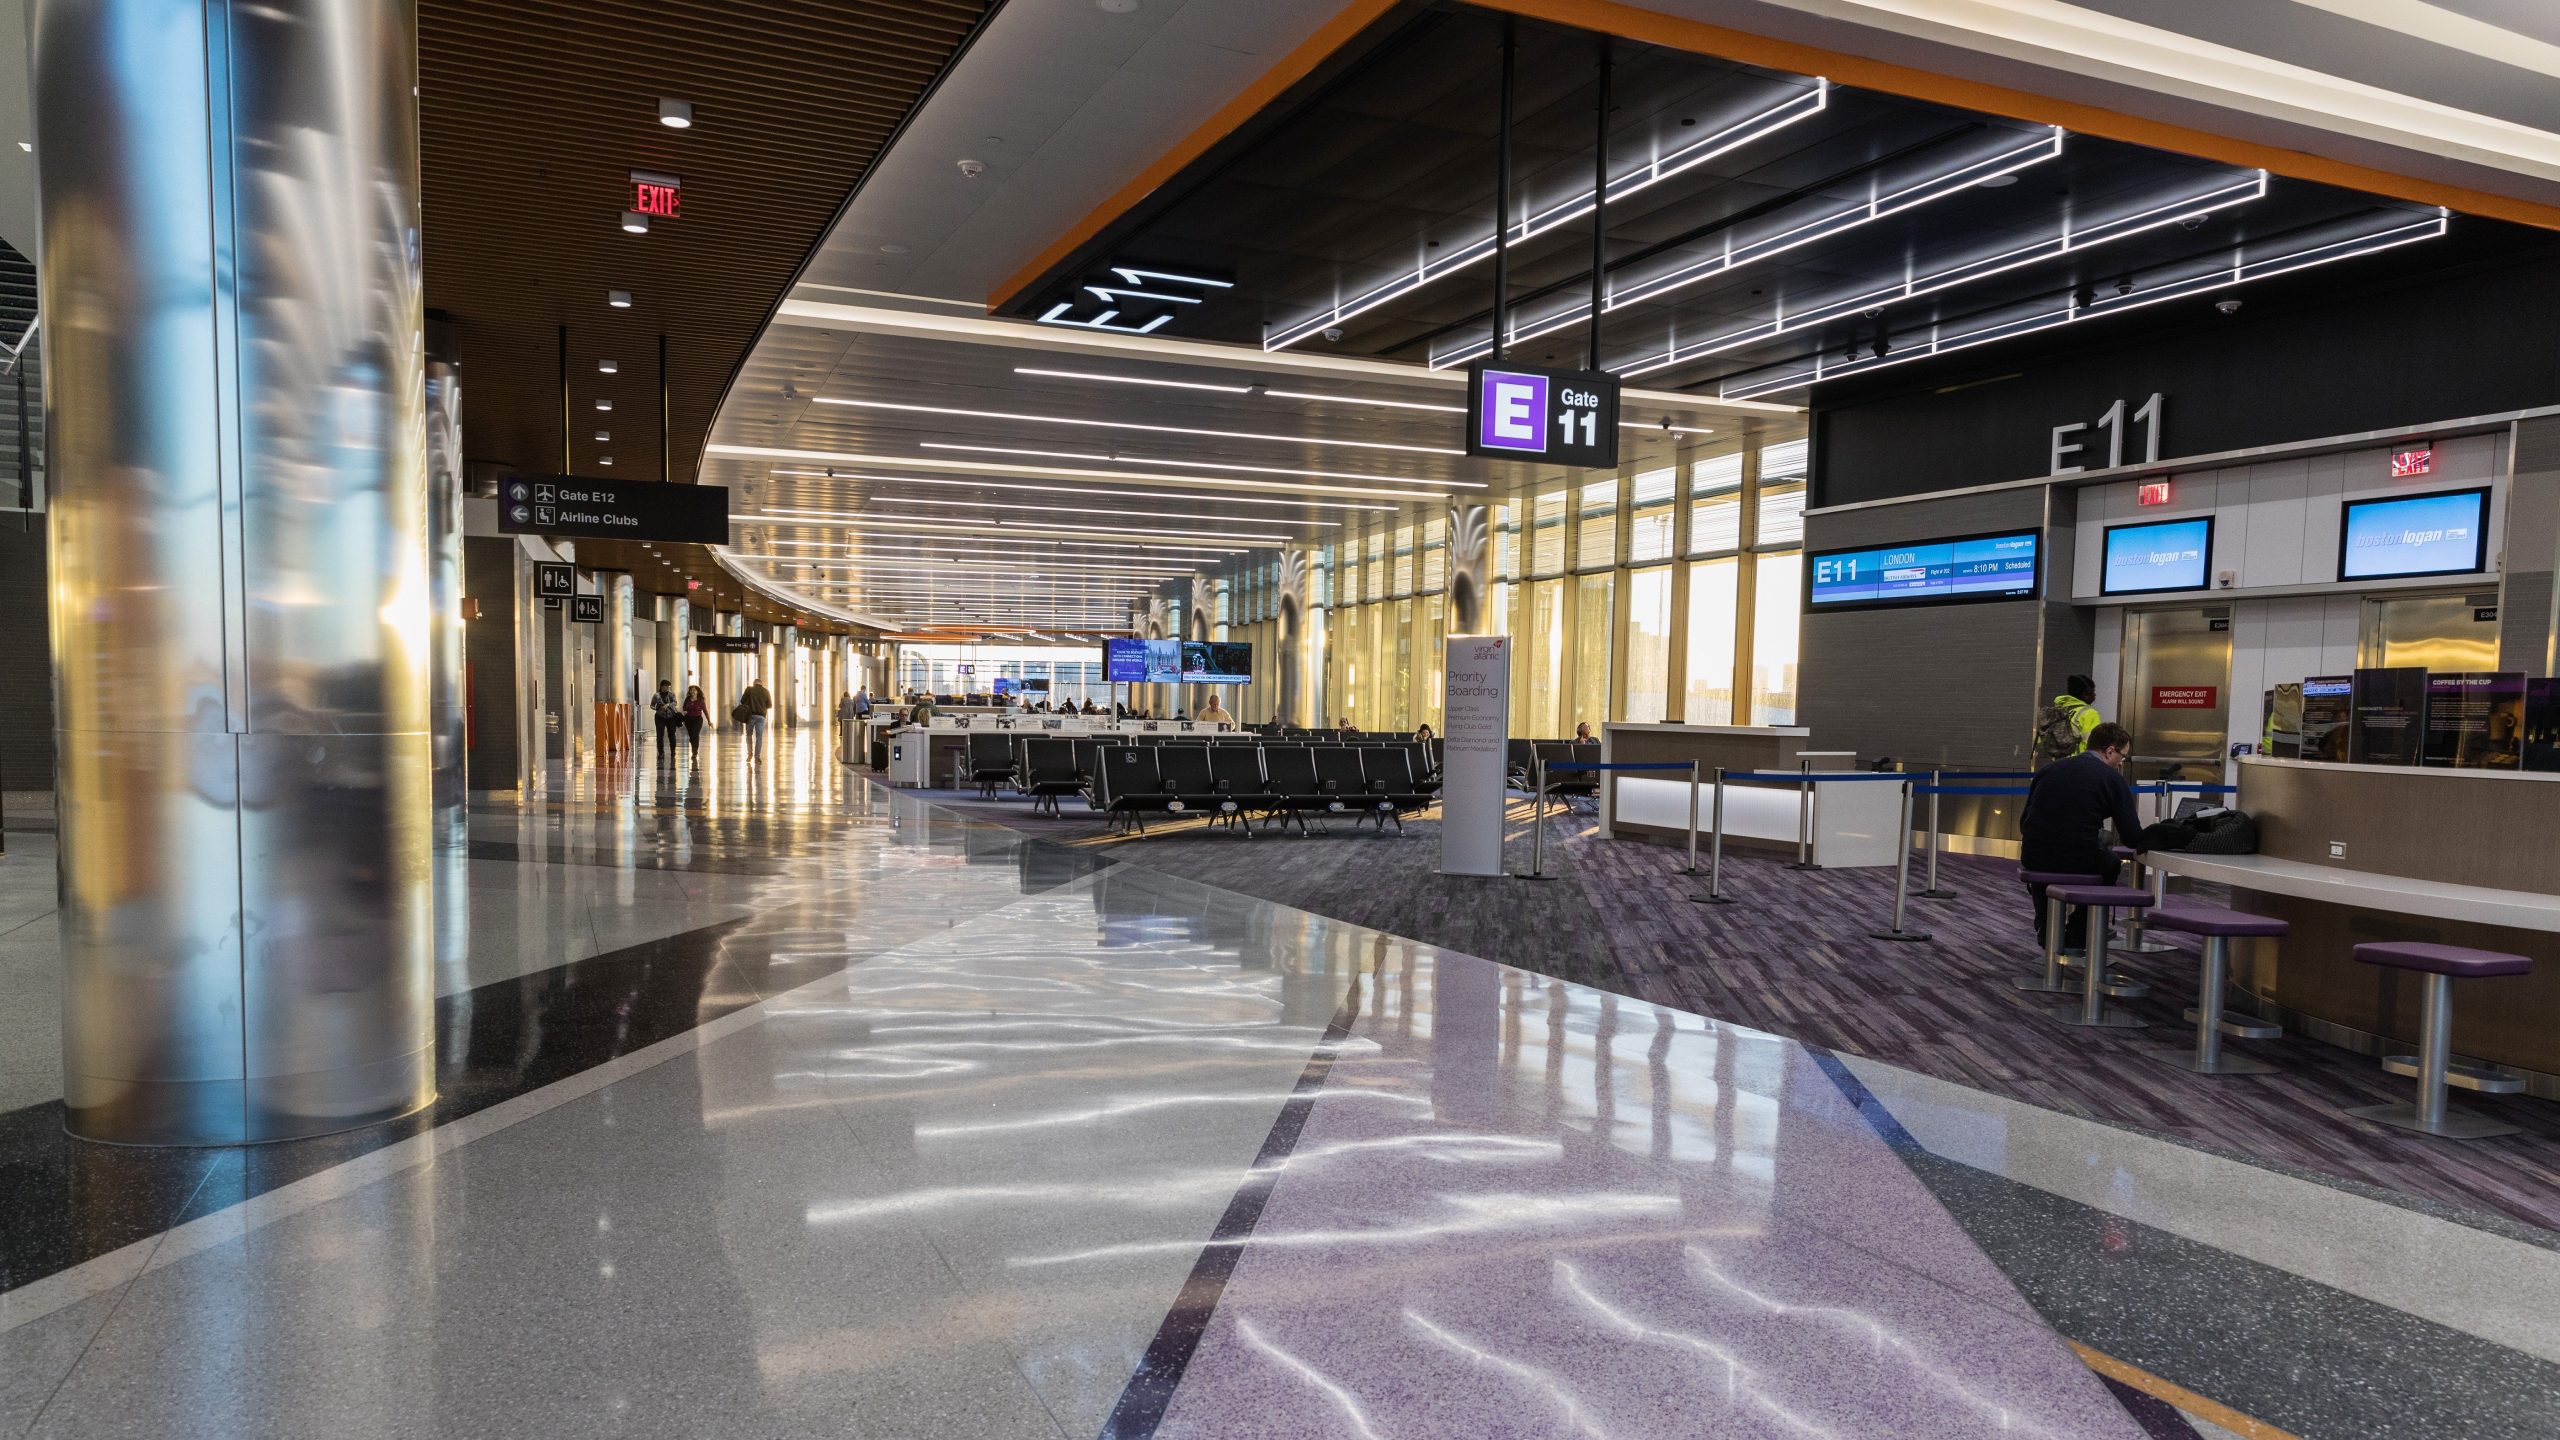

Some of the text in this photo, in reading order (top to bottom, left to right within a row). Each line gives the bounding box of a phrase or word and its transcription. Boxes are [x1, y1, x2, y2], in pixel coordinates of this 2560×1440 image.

[638, 184, 674, 214] EXIT
[1561, 388, 1599, 408] Gate
[1494, 382, 1533, 440] E
[1558, 409, 1597, 447] 11
[2051, 392, 2162, 477] E11
[559, 490, 615, 503] Gate E12
[2143, 485, 2167, 504] EXIT
[559, 512, 639, 526] Airline Clubs
[2356, 529, 2442, 548] bostonlogan
[1884, 553, 1916, 566] LONDON
[1974, 564, 1988, 573] 8:10
[1988, 563, 1999, 572] PM
[2005, 560, 2032, 570] Scheduled
[2114, 551, 2179, 567] bostonlogan
[1817, 559, 1857, 583] E11
[1474, 645, 1495, 654] virgin
[1448, 671, 1487, 684] Priority
[1448, 686, 1498, 698] Boarding
